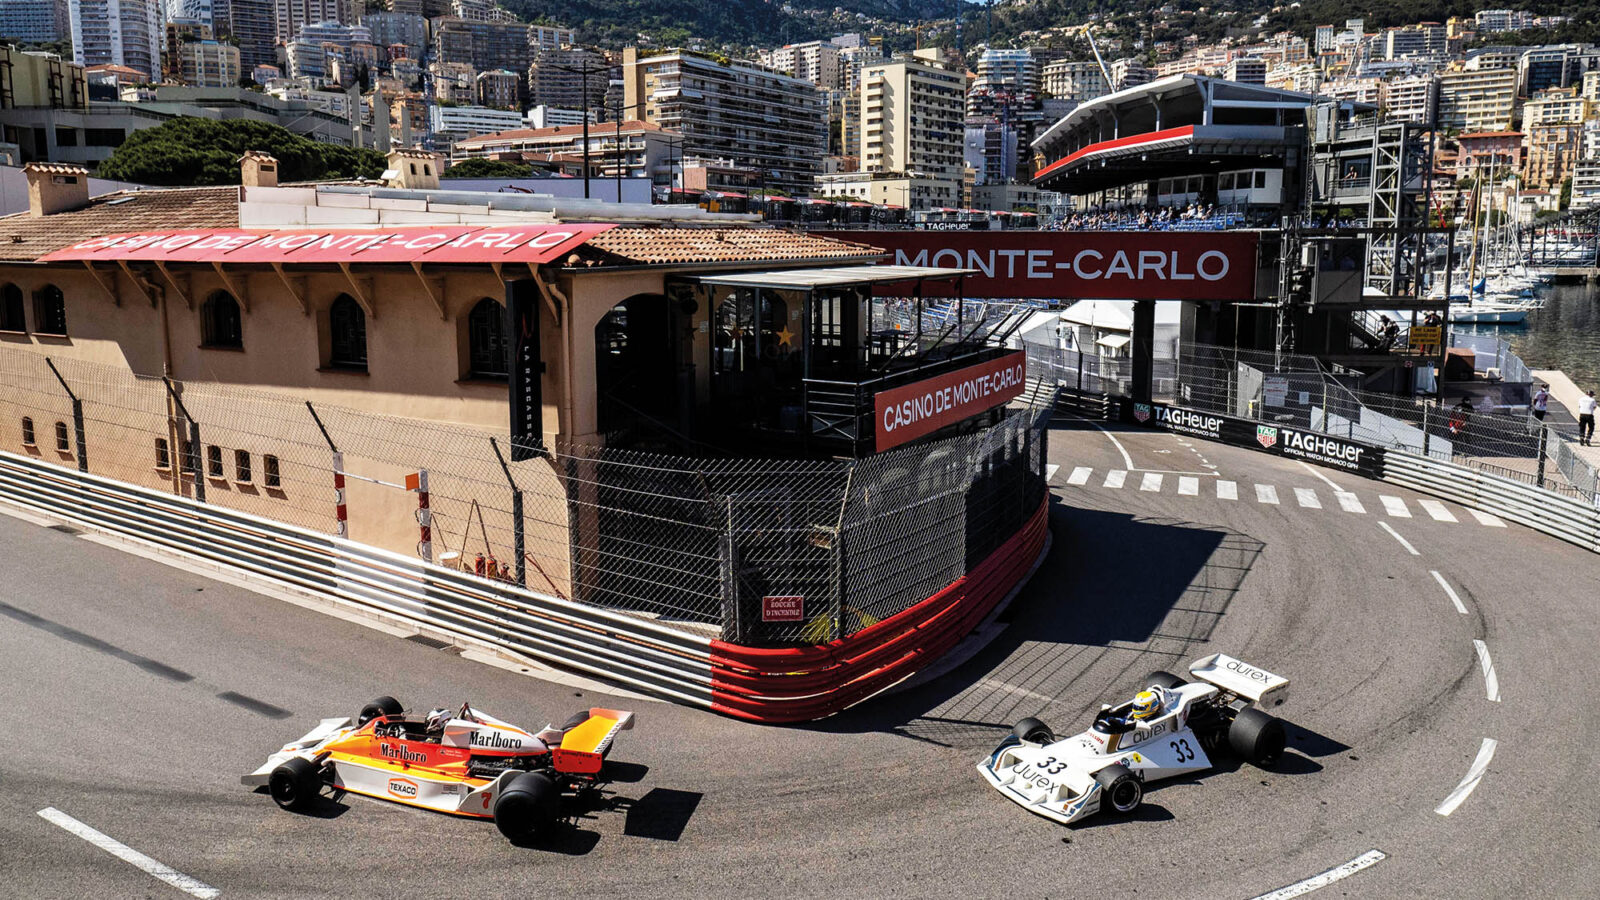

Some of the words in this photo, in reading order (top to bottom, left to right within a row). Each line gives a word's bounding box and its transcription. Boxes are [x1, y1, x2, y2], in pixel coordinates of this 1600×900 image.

[73, 235, 200, 250] CASINO
[189, 235, 246, 250] DE
[250, 231, 573, 250] MONTE-CARLO
[895, 248, 1230, 281] MONTE-CARLO
[524, 346, 530, 361] LA
[884, 393, 933, 432] CASINO
[935, 386, 952, 414] DE
[953, 364, 1023, 407] MONTE-CARLO
[1189, 428, 1210, 437] MONACO
[1258, 426, 1276, 437] TAG
[1284, 447, 1306, 457] OFFICIAL
[1306, 451, 1324, 461] WATCH
[1323, 456, 1347, 467] MONACO
[1226, 660, 1273, 684] durex
[469, 730, 522, 750] Marlboro
[380, 742, 427, 763] Marlboro
[1170, 738, 1195, 763] 33
[1037, 757, 1067, 775] 33
[389, 781, 417, 796] TEXACO
[1012, 764, 1060, 794] durex
[481, 791, 492, 810] 7
